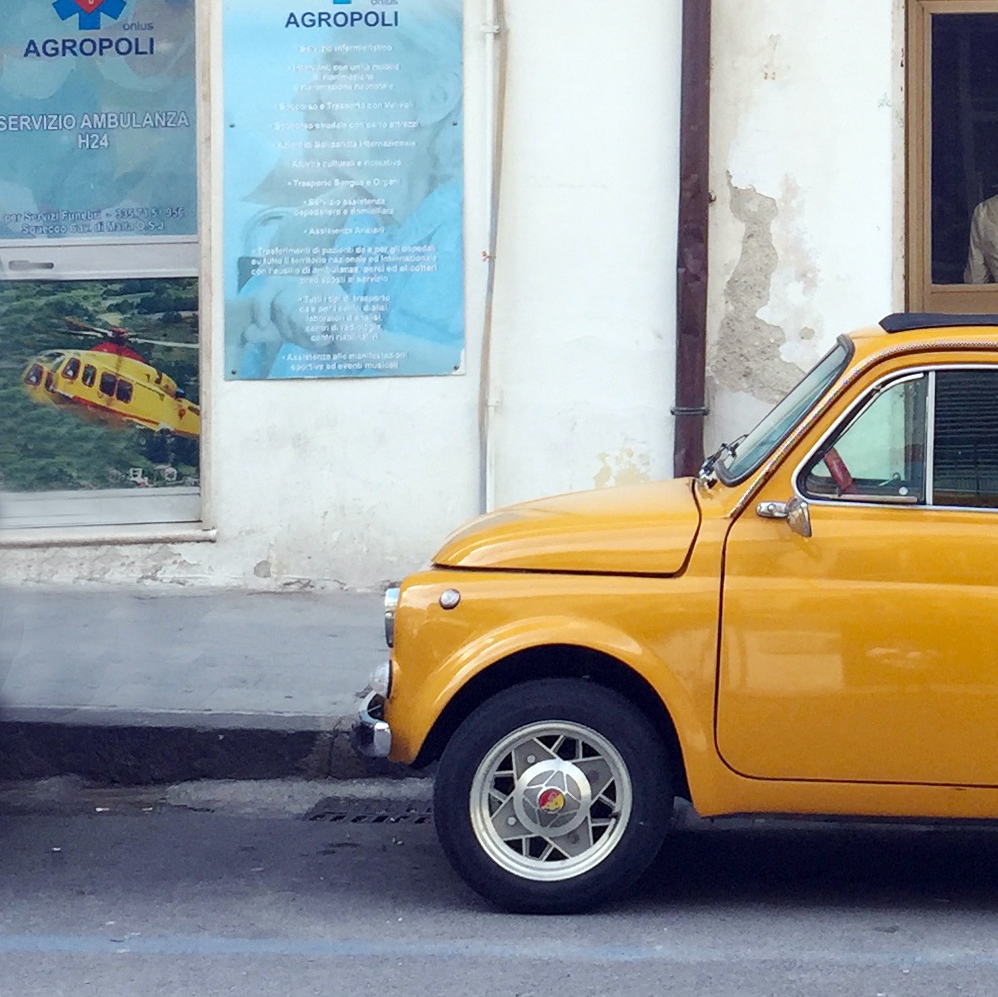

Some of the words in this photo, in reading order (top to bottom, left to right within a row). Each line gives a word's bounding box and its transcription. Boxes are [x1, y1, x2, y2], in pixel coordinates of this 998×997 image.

[123, 21, 154, 31] onlus
[285, 11, 399, 28] AGROPOLI
[23, 37, 155, 58] AGROPOLI
[0, 115, 76, 131] SERVIZIO
[80, 111, 190, 129] AMBULANZA
[78, 133, 110, 149] H24
